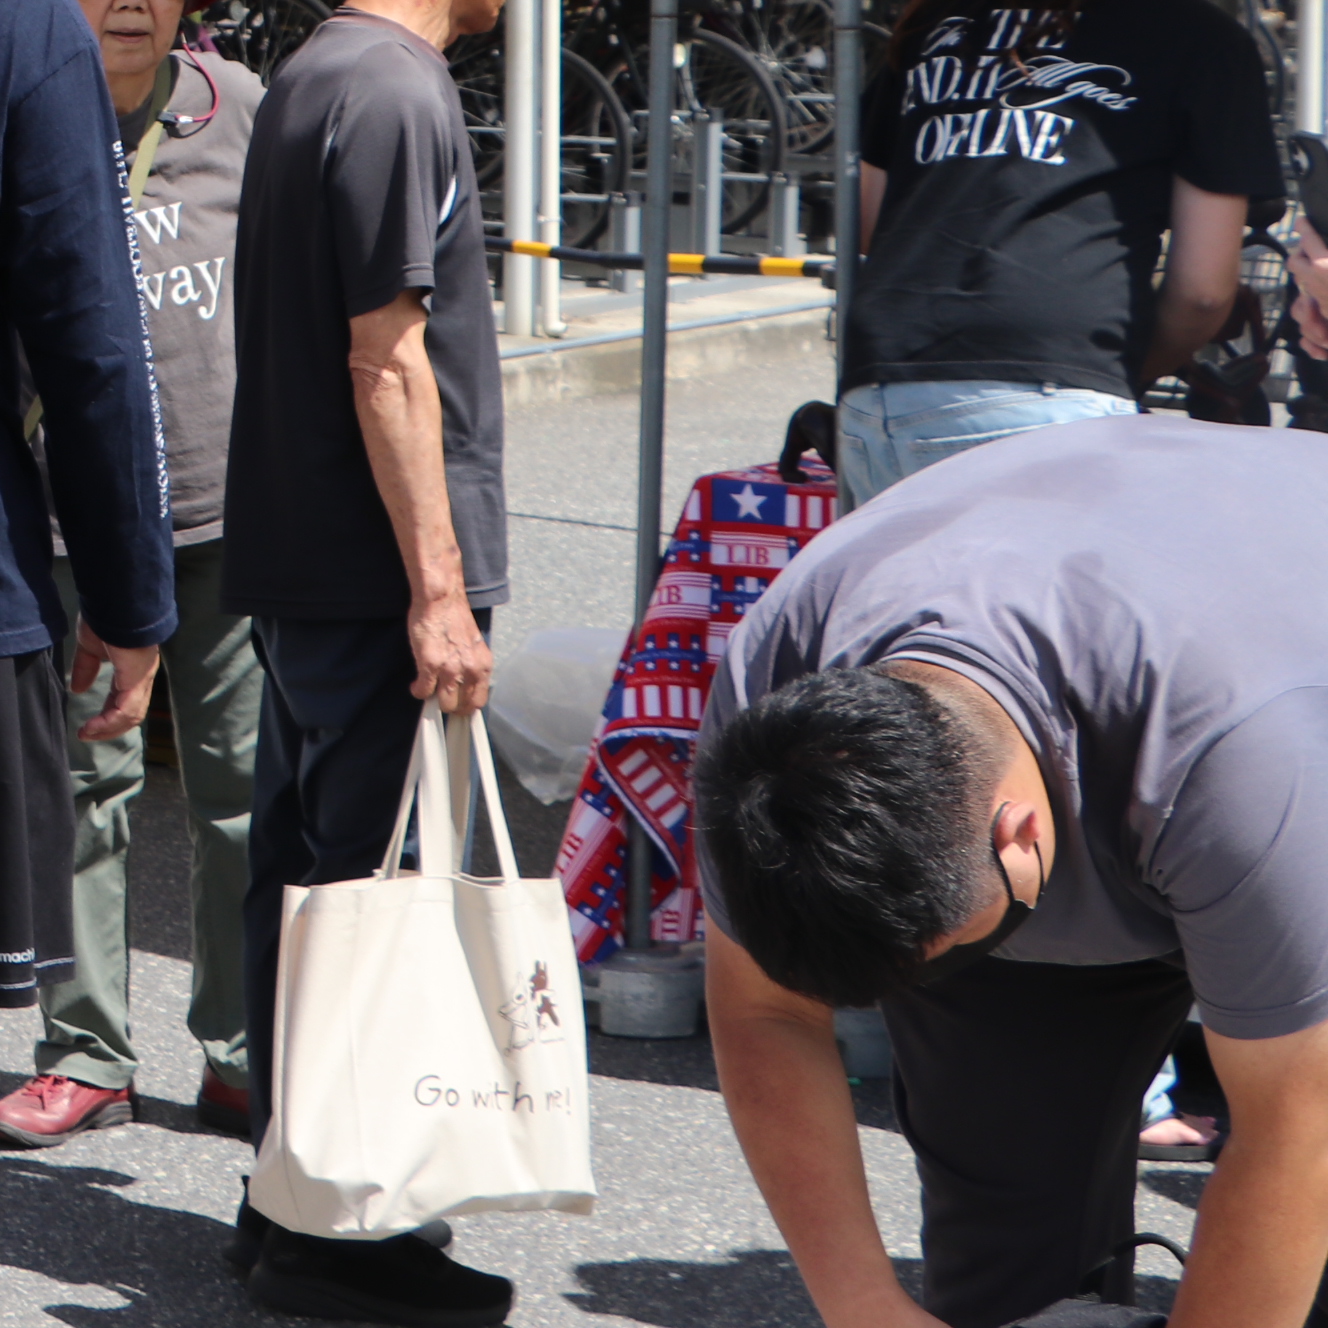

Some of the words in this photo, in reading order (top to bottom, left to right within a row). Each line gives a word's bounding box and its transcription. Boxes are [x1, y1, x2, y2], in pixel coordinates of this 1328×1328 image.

[134, 201, 183, 244] w
[727, 544, 770, 565] LIB
[414, 1074, 460, 1107] Go
[471, 1080, 535, 1113] with
